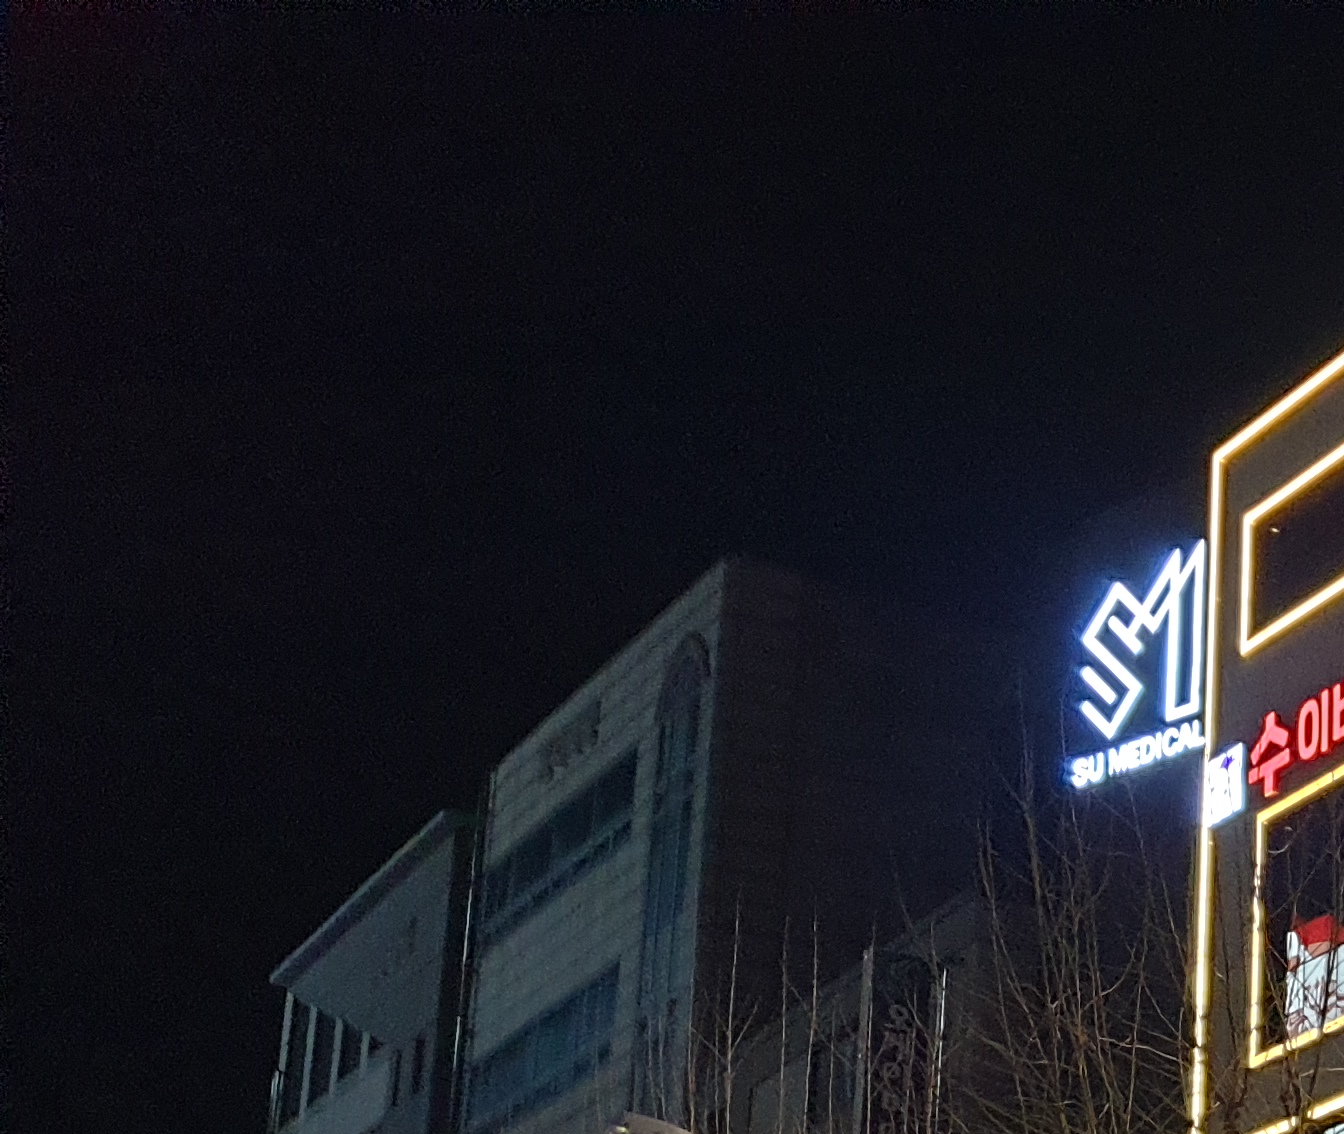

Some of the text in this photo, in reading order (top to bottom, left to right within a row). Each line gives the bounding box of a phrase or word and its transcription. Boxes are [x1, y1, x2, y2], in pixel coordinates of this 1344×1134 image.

[1071, 719, 1205, 790] SU MEDICAL
[1248, 710, 1291, 797] 수
